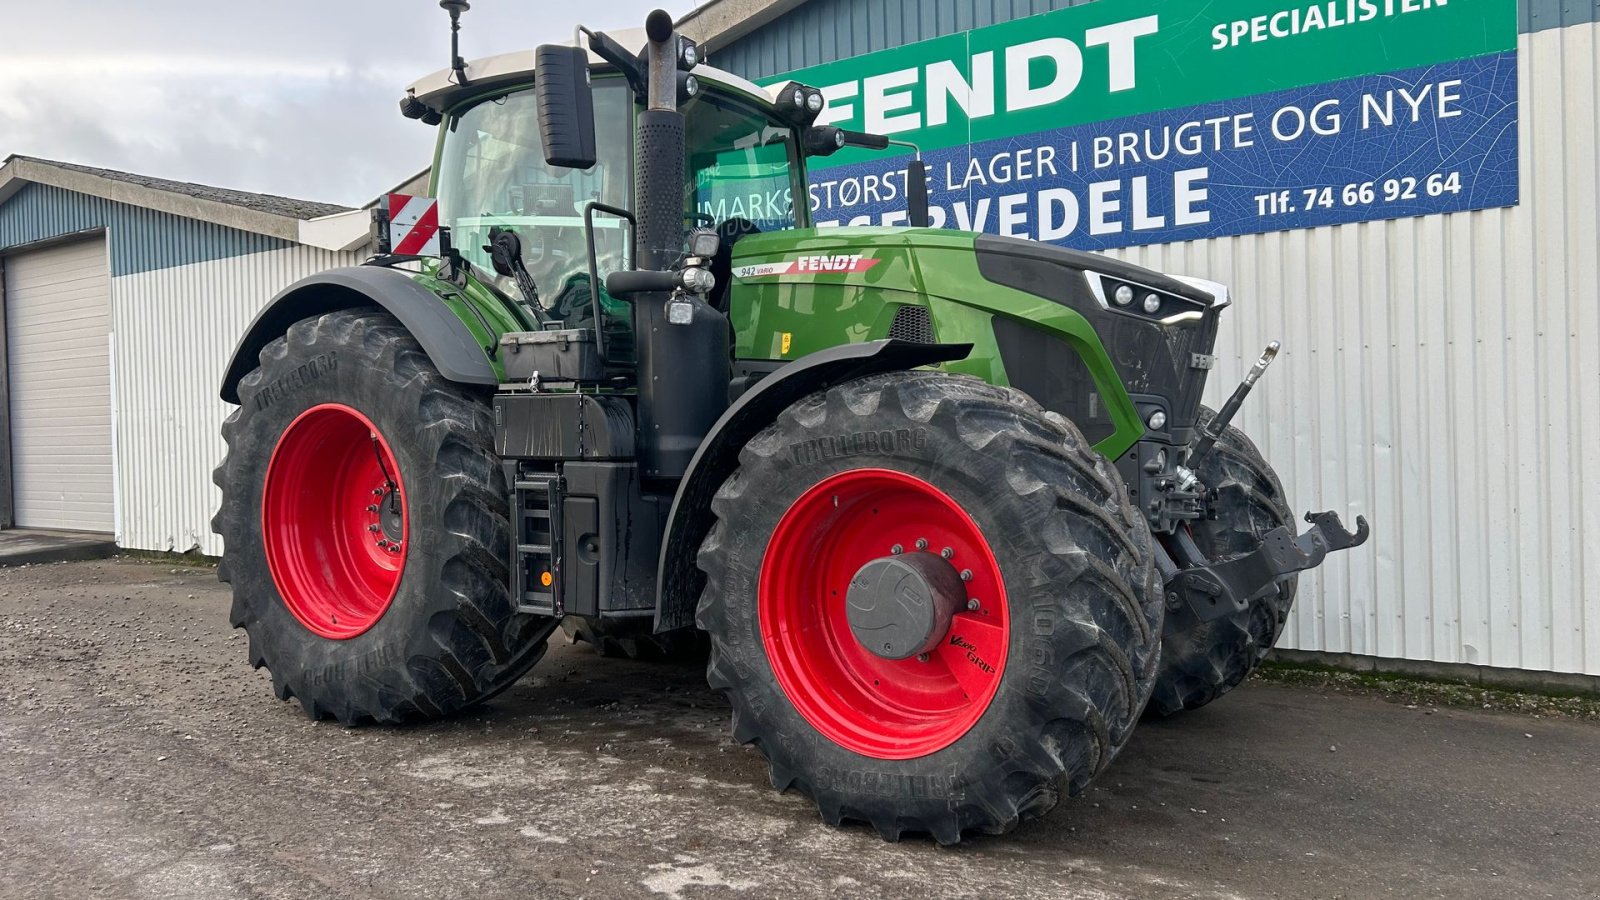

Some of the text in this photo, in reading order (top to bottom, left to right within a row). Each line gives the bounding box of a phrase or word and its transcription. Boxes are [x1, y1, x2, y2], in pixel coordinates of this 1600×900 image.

[811, 15, 1159, 136] FENDT
[697, 188, 794, 227] MARKS
[946, 146, 1058, 191] LAGER
[1071, 141, 1078, 172] I
[1093, 112, 1254, 169] BRUGTE
[1271, 99, 1341, 142] OG
[1361, 79, 1462, 130] NYE
[782, 167, 1211, 242] VEDELE
[1255, 171, 1462, 216] Tlf. 74 66 92 64
[741, 267, 756, 277] 942
[797, 254, 864, 271] FENDT
[788, 426, 928, 466] TRELLEBORG
[966, 651, 996, 674] GRIP
